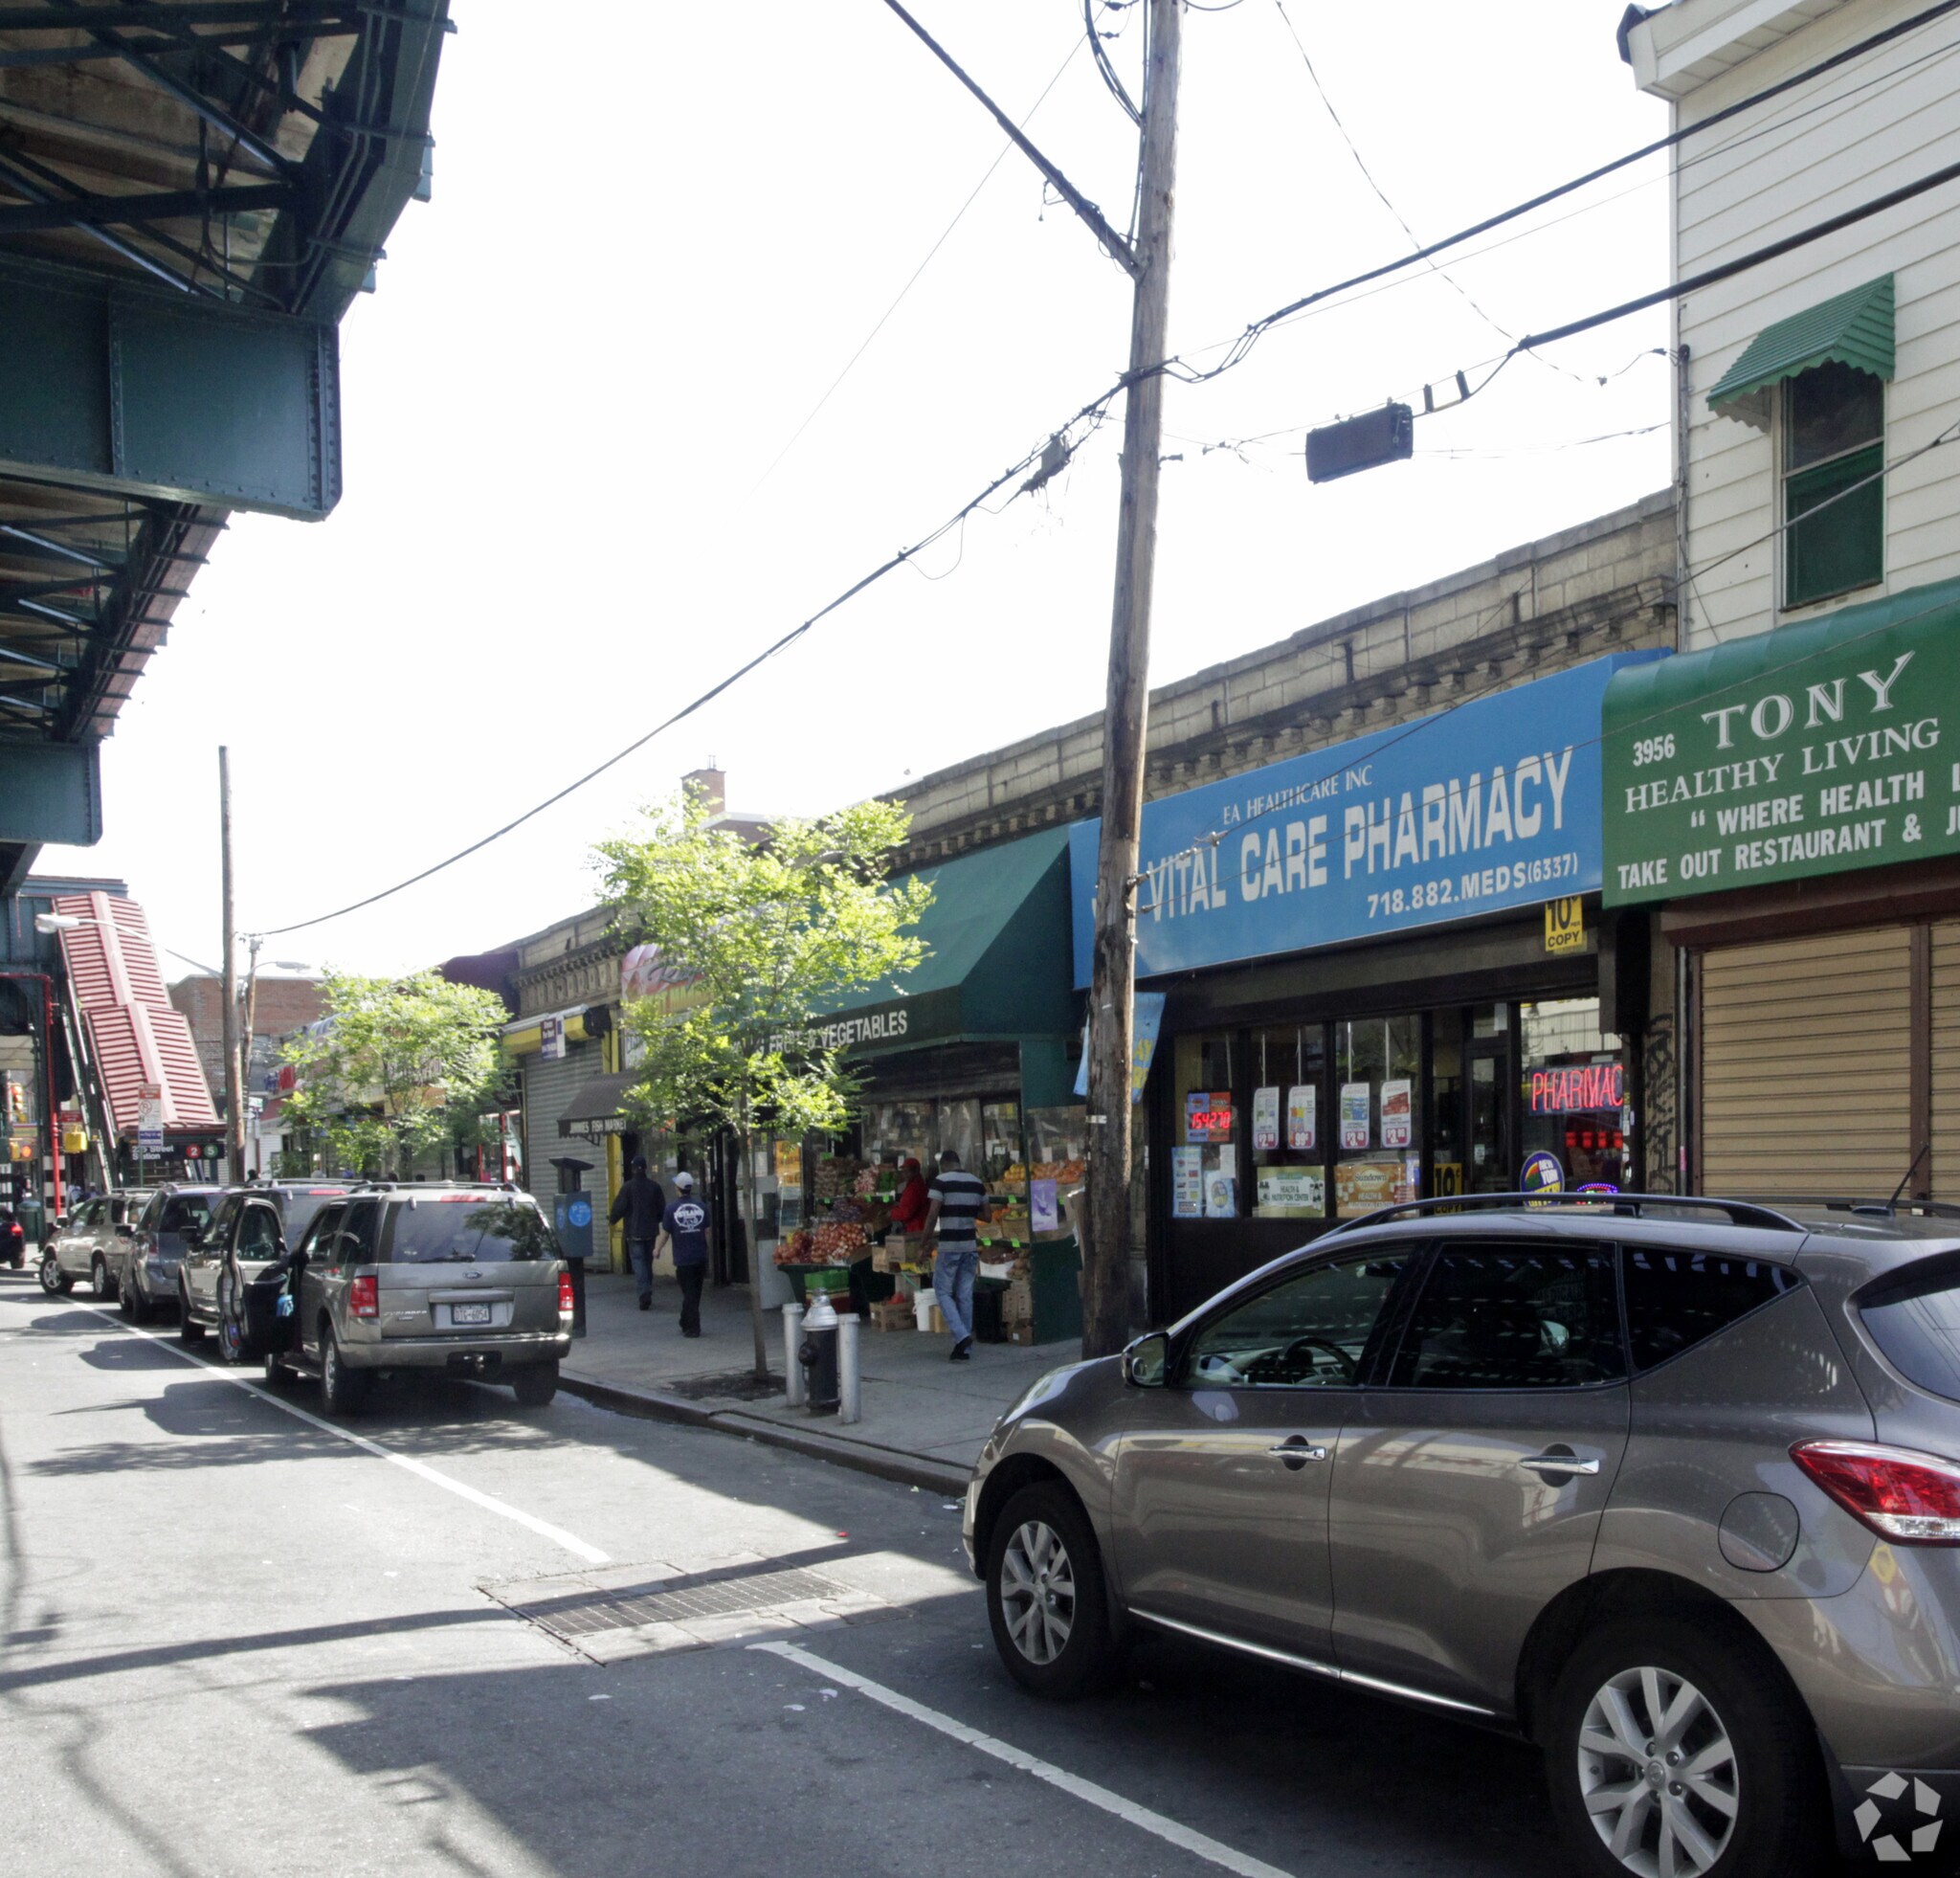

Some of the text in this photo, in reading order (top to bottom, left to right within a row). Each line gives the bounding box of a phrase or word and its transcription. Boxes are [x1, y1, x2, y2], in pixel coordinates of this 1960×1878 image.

[1701, 650, 1916, 749] TONY
[1625, 718, 1941, 814] HEALTHY LIVING
[1633, 733, 1676, 767] 3956
[1223, 765, 1373, 825] EA HEALTHCARE INC
[1717, 794, 1804, 836] WHERE
[1820, 770, 1925, 816] HEALTH
[1147, 746, 1574, 923] VITAL CARE PHARMACY
[1618, 859, 1667, 890] TAKE
[1680, 849, 1722, 880] OUT
[1735, 818, 1886, 871] RESTAURANT
[1902, 813, 1923, 842] &
[1548, 930, 1580, 948] COPY
[820, 1010, 907, 1048] VEGETABLES
